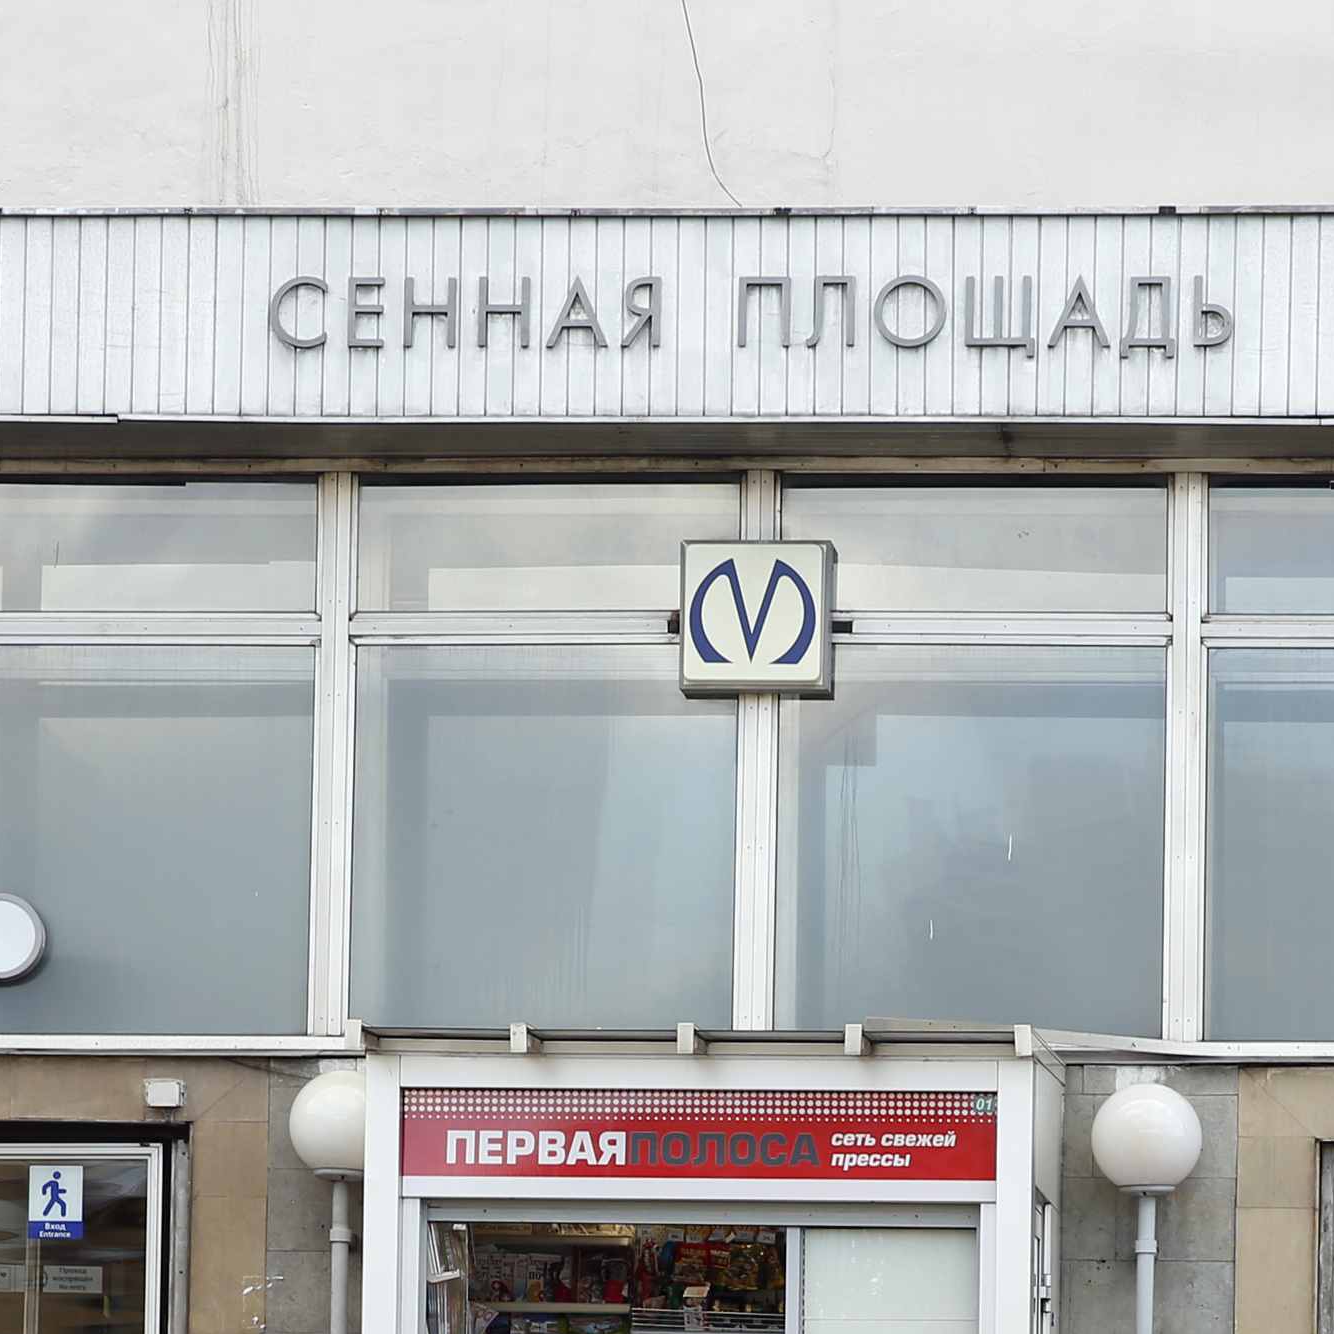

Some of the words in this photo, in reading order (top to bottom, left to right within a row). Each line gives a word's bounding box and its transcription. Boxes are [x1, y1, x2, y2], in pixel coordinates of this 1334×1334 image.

[268, 276, 663, 350] СЕННАЯ
[737, 275, 1235, 359] ПЛОЩАДЬ
[830, 1132, 876, 1147] сеть
[880, 1131, 957, 1147] свежей
[830, 1153, 911, 1171] прессы
[39, 1230, 71, 1238] Entrance
[44, 1222, 67, 1231] Вход
